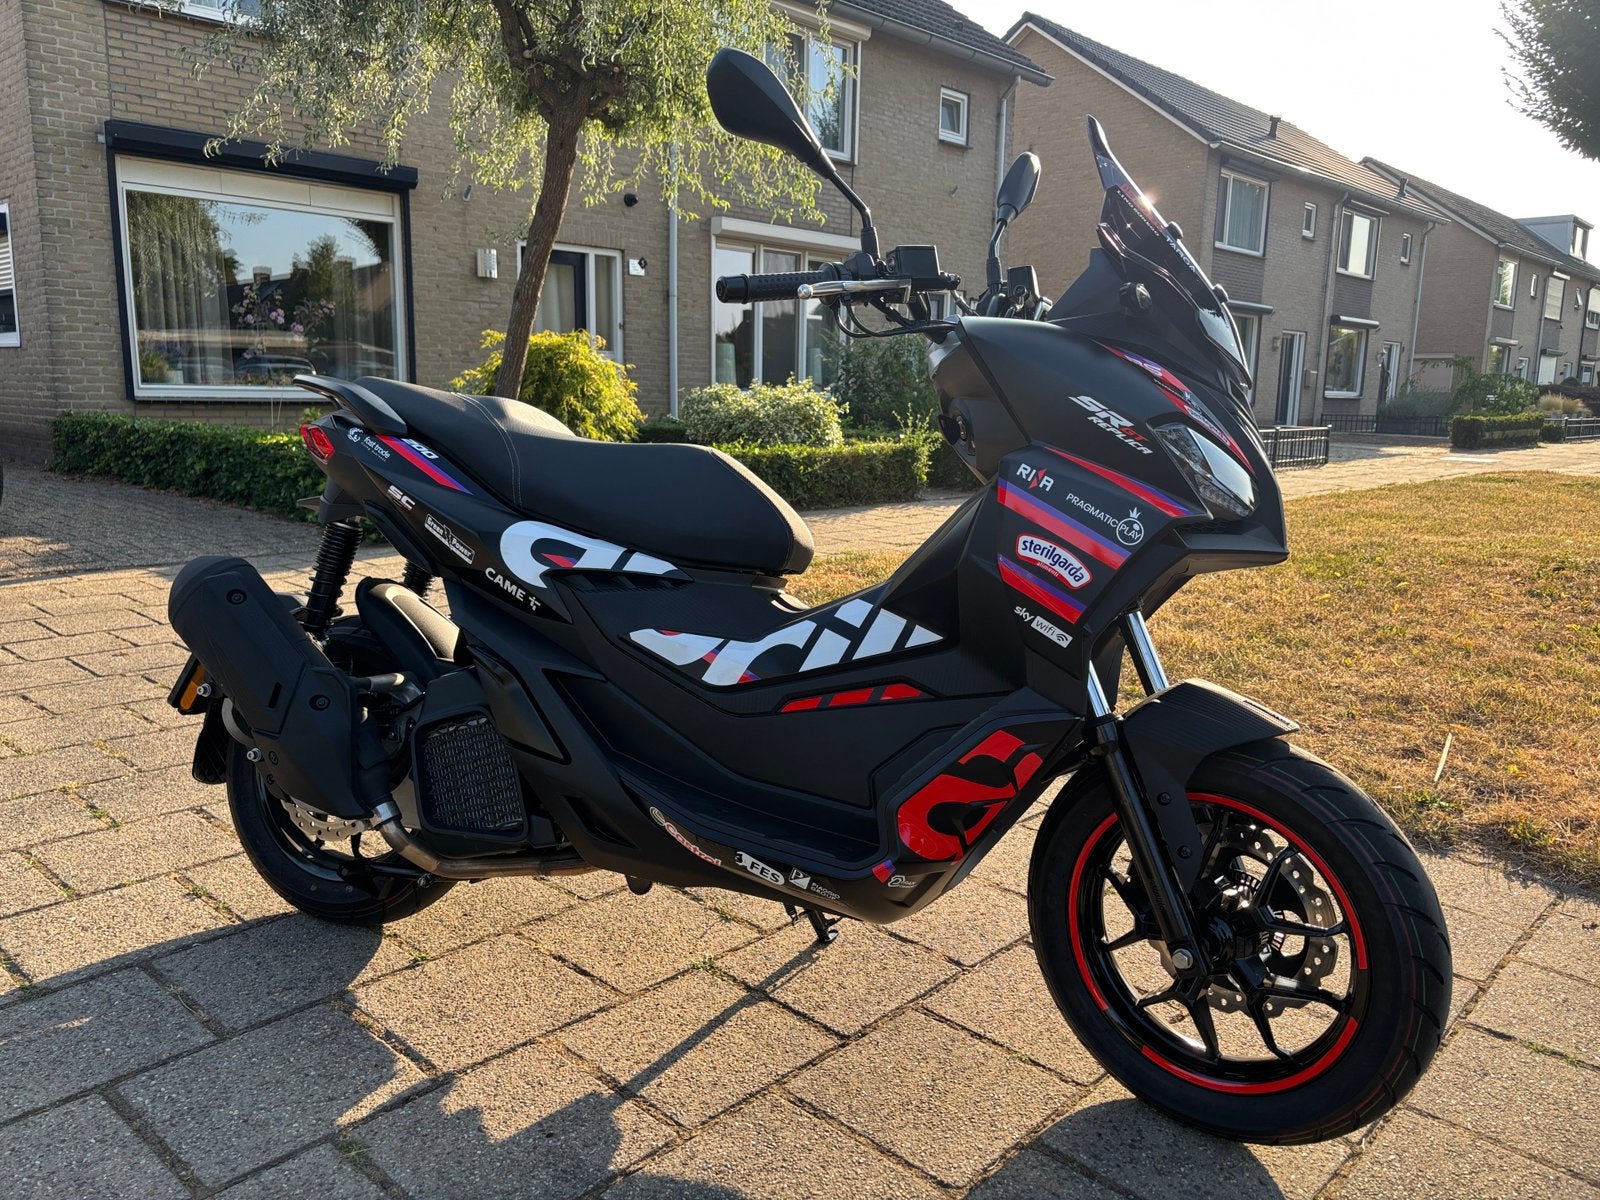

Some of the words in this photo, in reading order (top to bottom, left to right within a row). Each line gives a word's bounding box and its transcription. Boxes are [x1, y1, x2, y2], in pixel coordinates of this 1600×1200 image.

[1068, 395, 1135, 428] SR
[1119, 425, 1149, 442] GT
[1087, 416, 1153, 455] REPLICA
[1066, 493, 1119, 528] PRAGMATIC
[1119, 523, 1142, 541] PLAY
[451, 537, 472, 557] Power
[1021, 539, 1085, 583] sterilgarda
[485, 567, 525, 602] CAME
[1014, 605, 1035, 622] sky
[1035, 619, 1056, 636] wifi
[750, 860, 780, 883] FES
